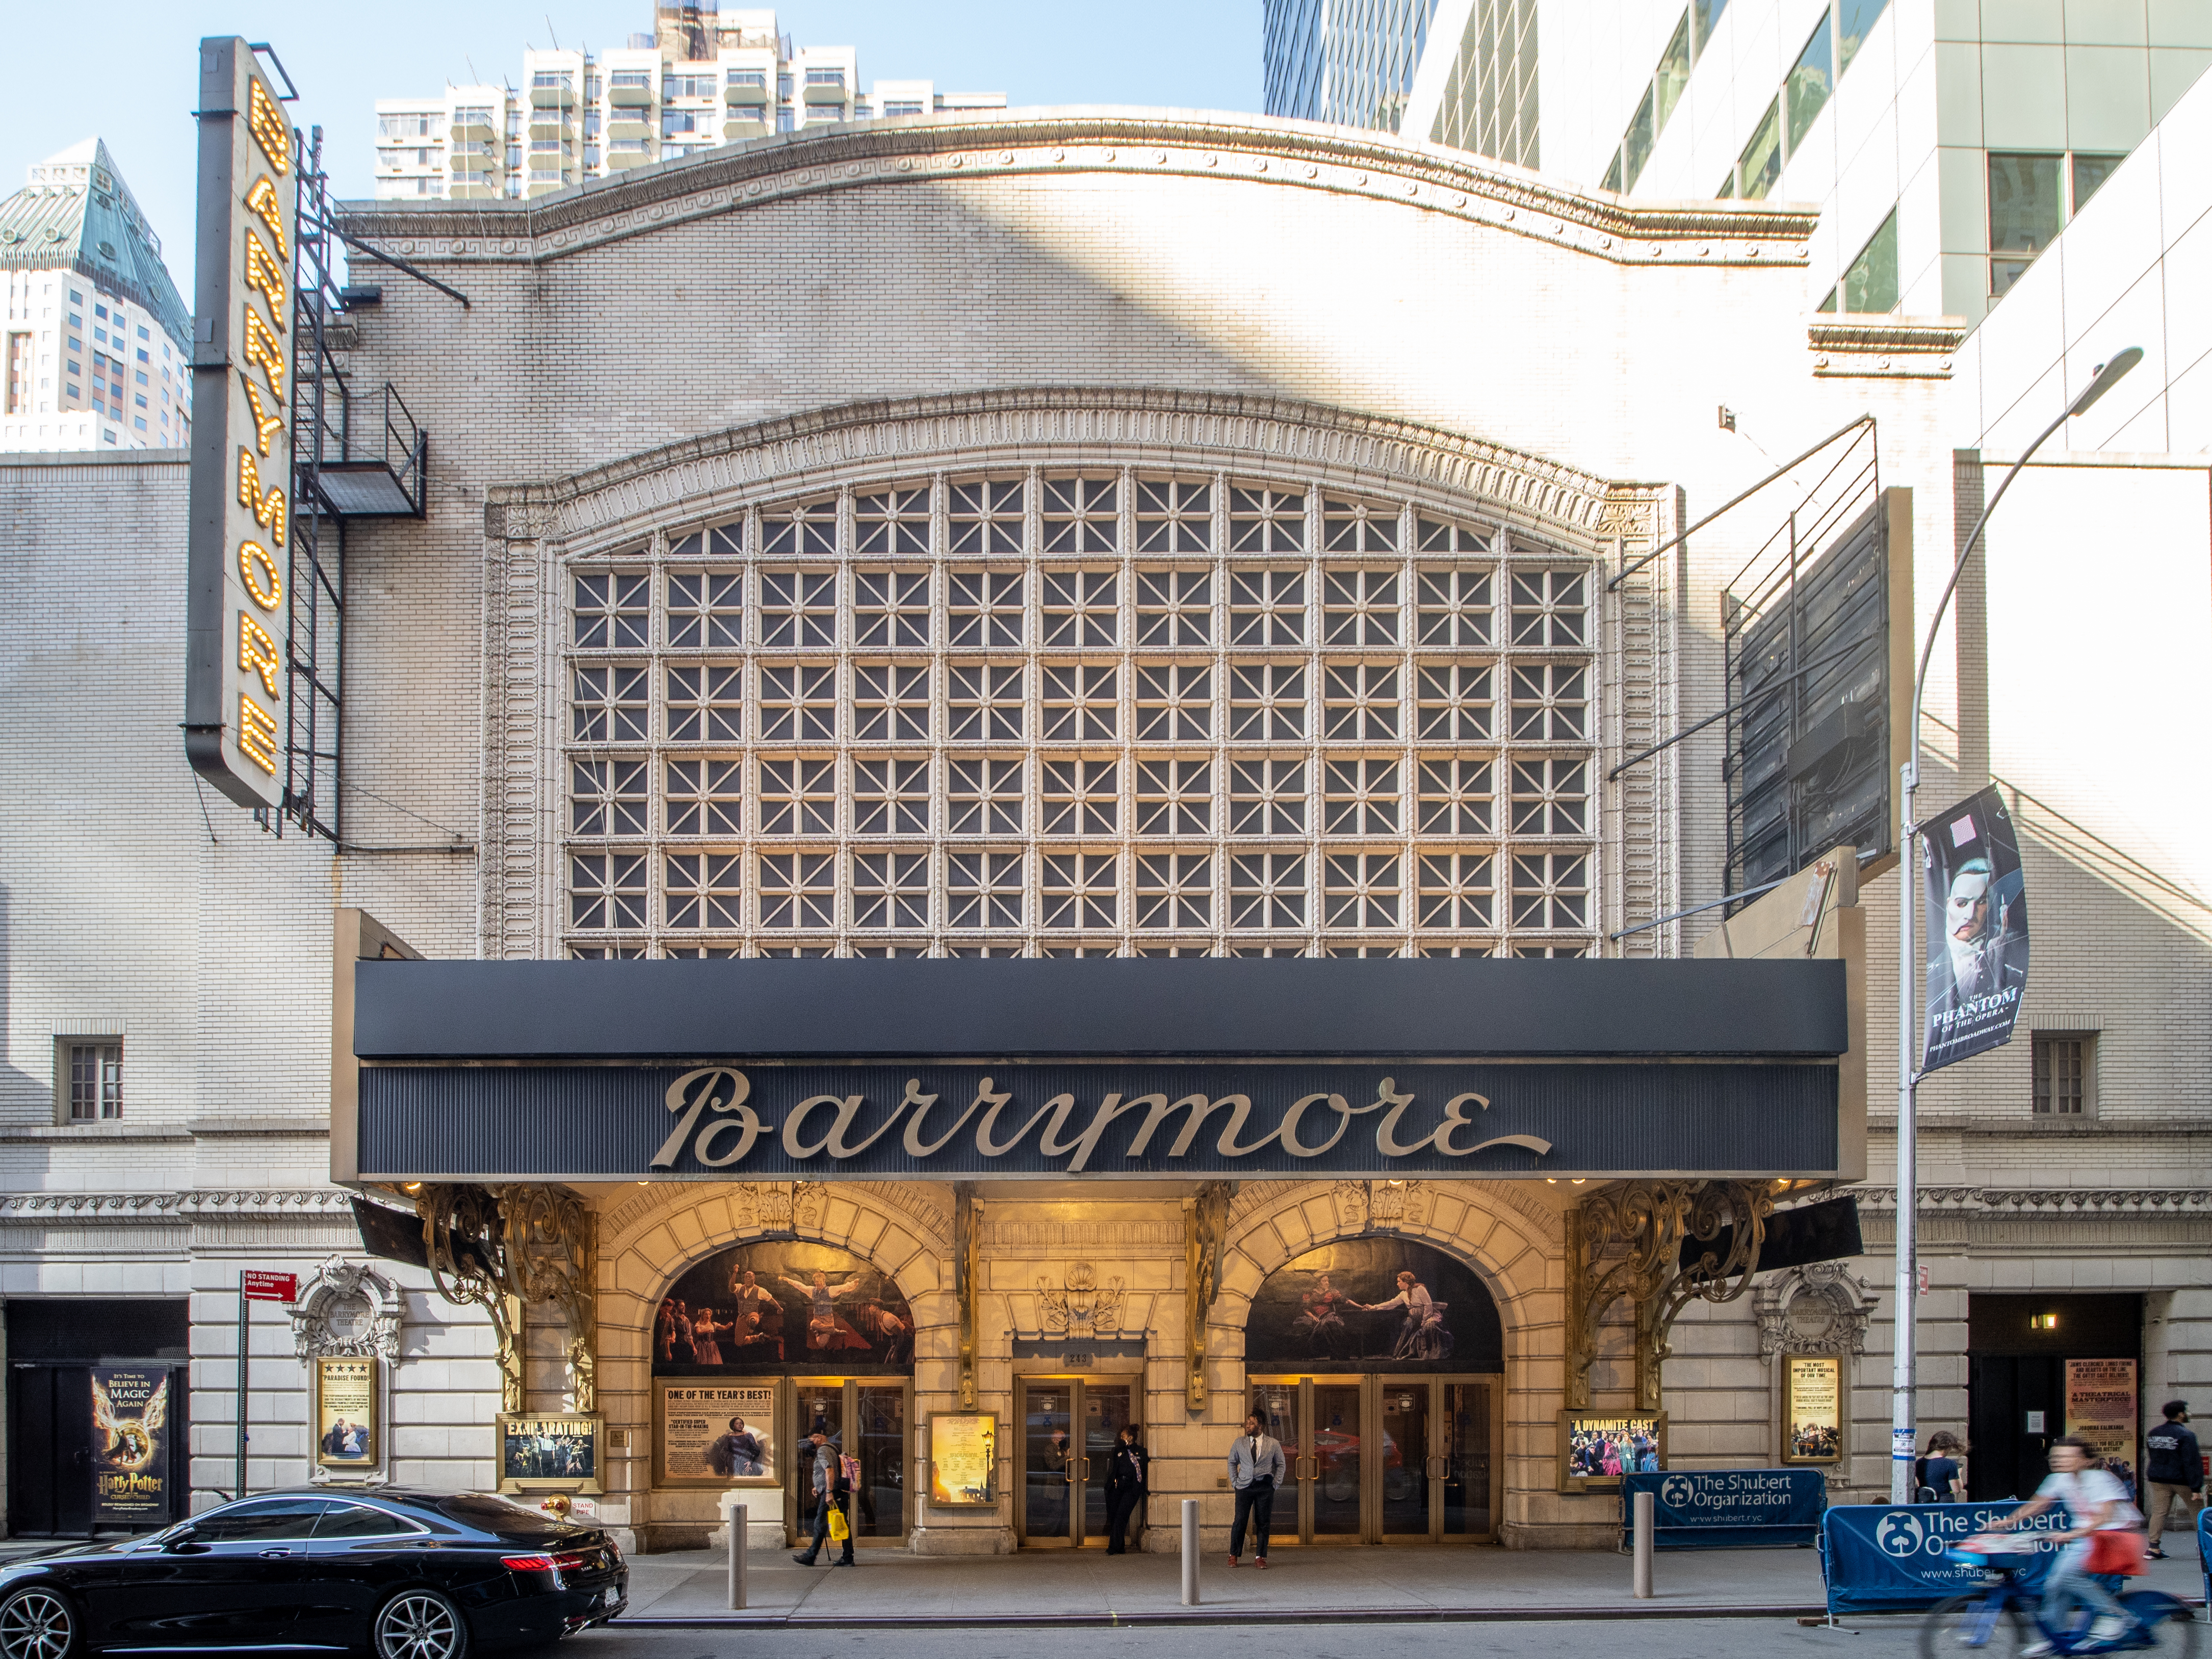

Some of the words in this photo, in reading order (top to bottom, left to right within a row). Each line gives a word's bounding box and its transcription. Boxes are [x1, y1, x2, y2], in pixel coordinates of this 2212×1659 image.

[238, 74, 289, 775] BARRYMORE
[1969, 992, 1983, 1001] THE
[1933, 987, 2018, 1027] PHANTOM
[1941, 1024, 1954, 1033] OF
[1956, 1018, 1972, 1029] THE
[1975, 1007, 2004, 1022] OPERA
[1929, 1019, 2011, 1053] PHANTOMBROADWAY.COM
[649, 1067, 1552, 1173] Barrymore
[258, 1274, 290, 1282] STANDING
[1070, 1354, 1086, 1363] 243
[111, 1388, 150, 1398] MAGIC
[667, 1390, 684, 1399] "ONE
[686, 1390, 697, 1399] OF
[699, 1390, 715, 1399] THE
[717, 1390, 745, 1399] YEAR'S
[747, 1390, 771, 1399] BEST!
[1583, 1419, 1628, 1431] DYNAMITE
[96, 1474, 129, 1495] Harry
[129, 1472, 163, 1494] Potter
[1694, 1475, 1725, 1490] The
[1728, 1474, 1791, 1490] Shubert
[1695, 1490, 1791, 1510] Organization
[1923, 1511, 1968, 1533] The
[1974, 1510, 2067, 1532] Shubert
